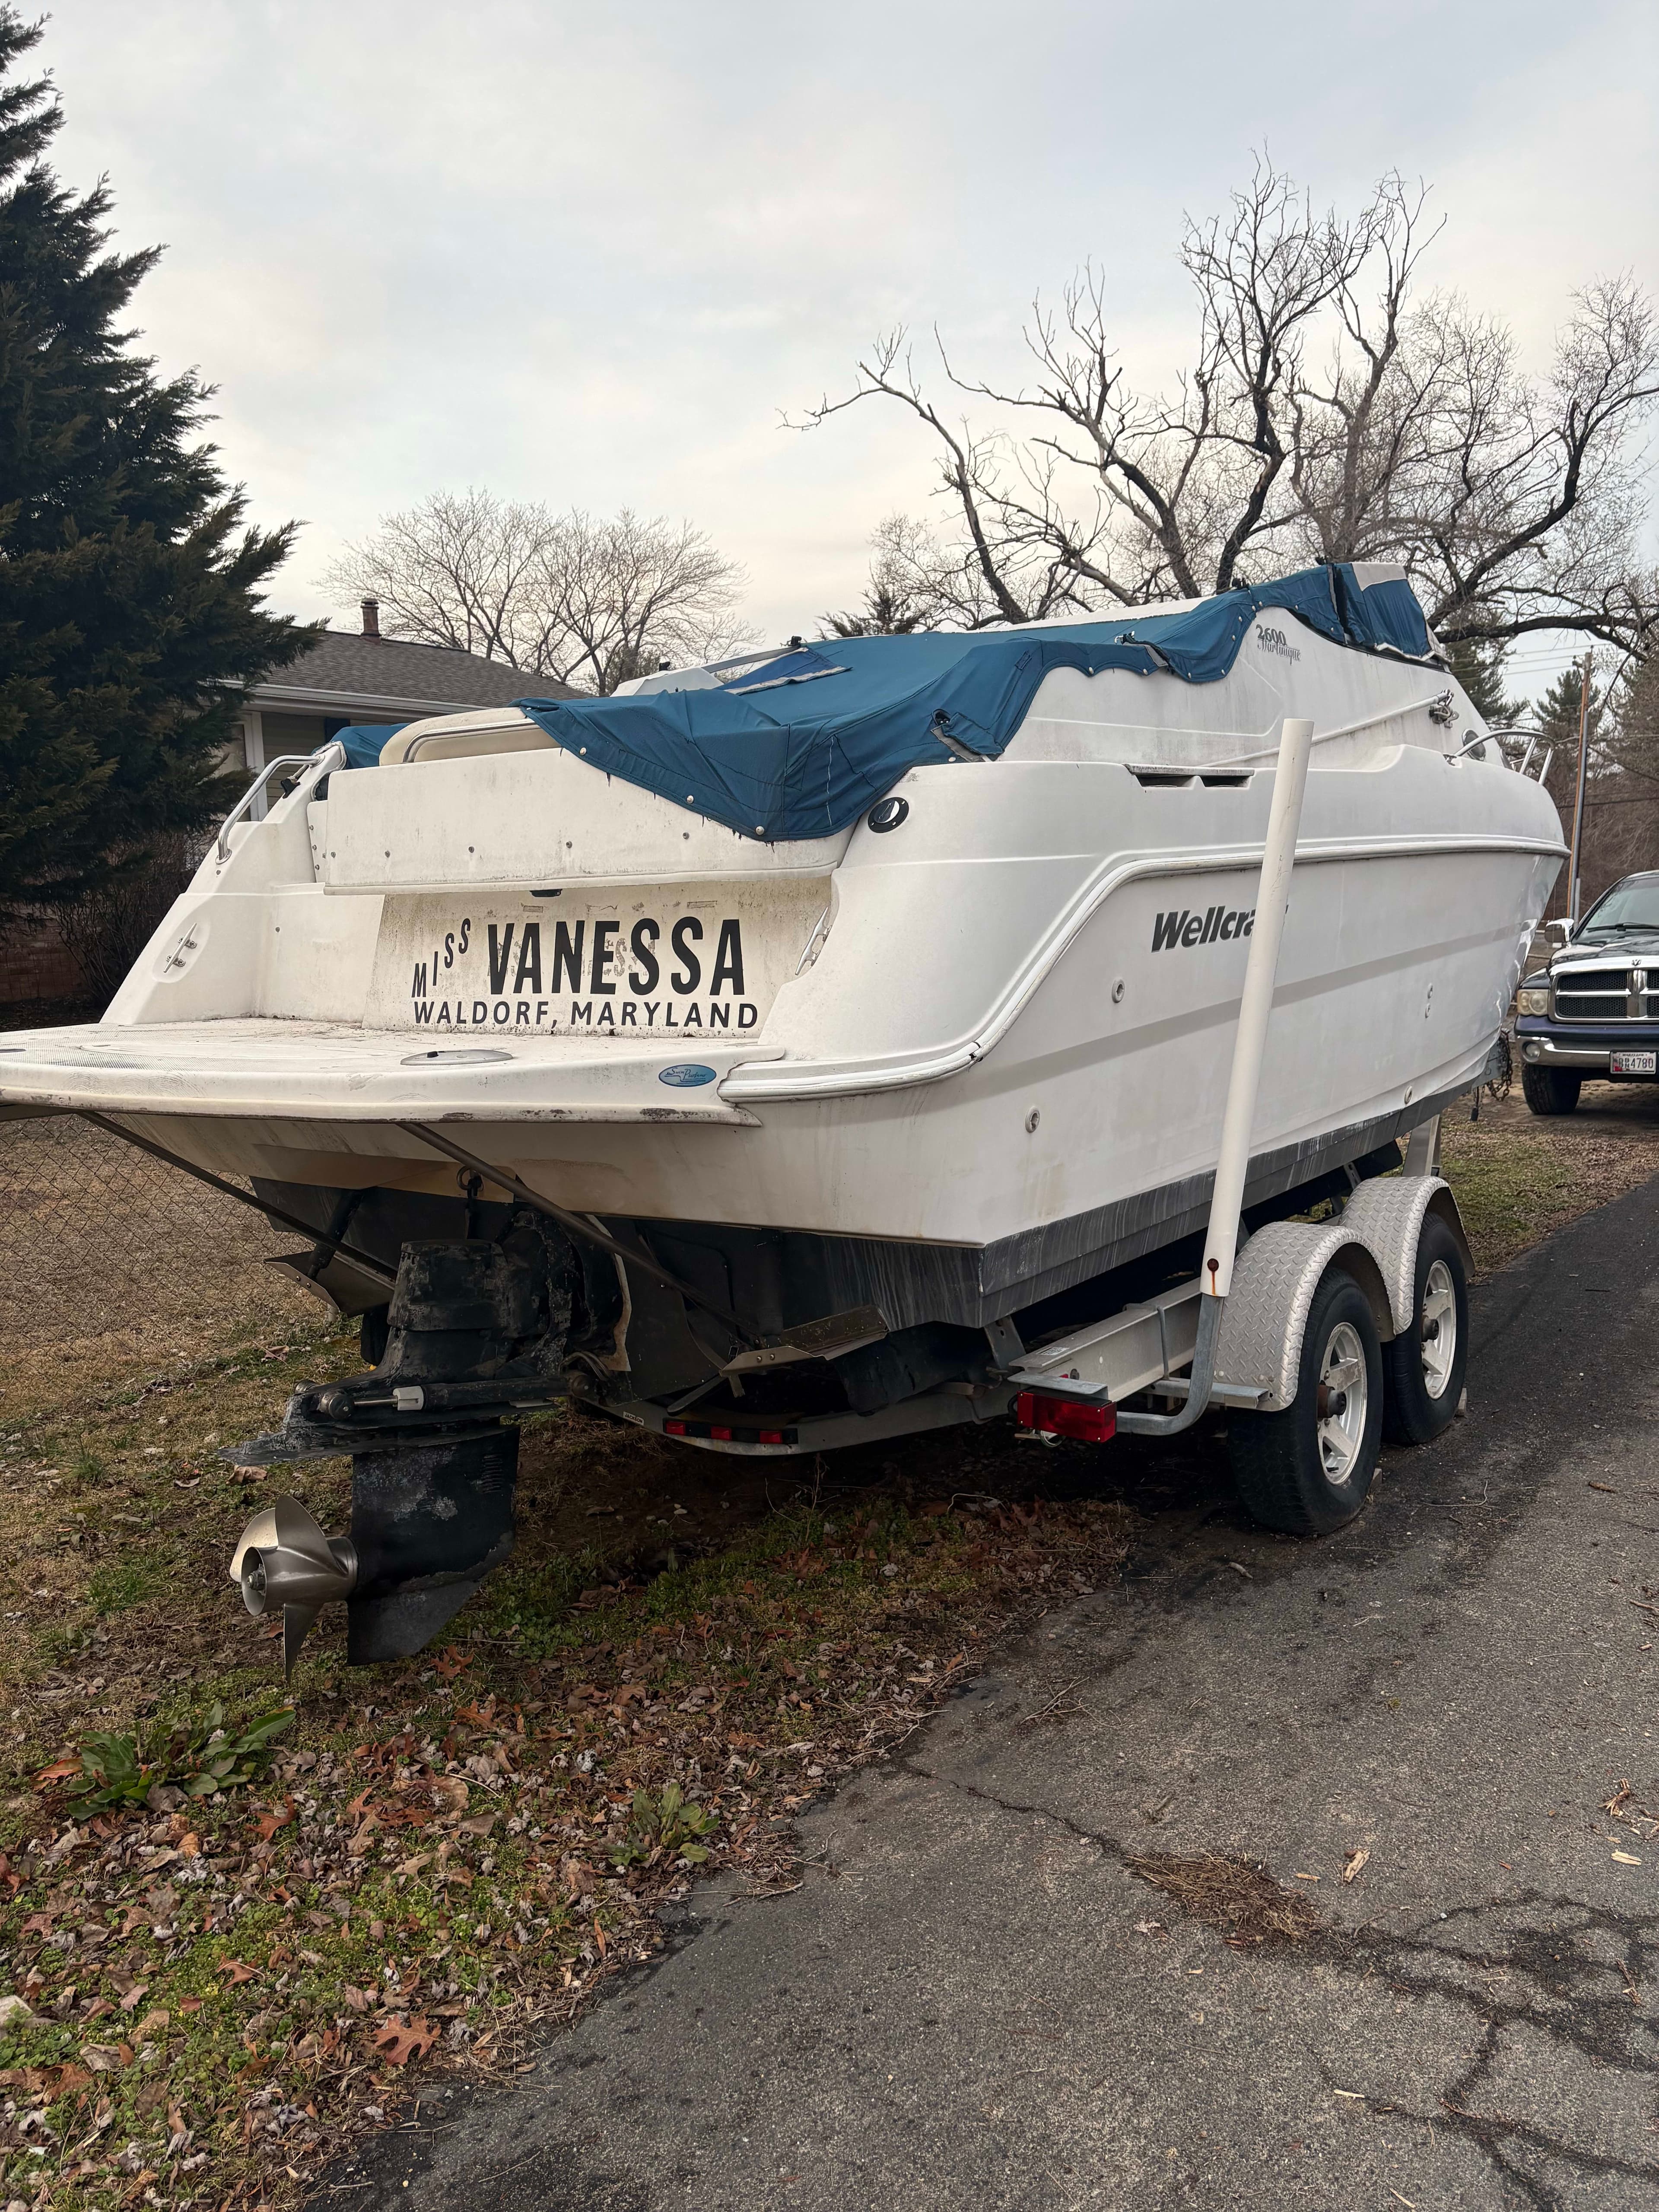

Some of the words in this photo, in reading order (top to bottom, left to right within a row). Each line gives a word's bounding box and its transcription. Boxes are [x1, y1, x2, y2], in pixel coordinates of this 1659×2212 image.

[1256, 624, 1287, 646] 2600
[1151, 905, 1289, 953] Wellcra
[411, 918, 471, 998] MISS
[488, 916, 745, 995] VANESSA
[414, 1001, 557, 1029] WALDORF,
[571, 1001, 757, 1028] MARYLAND
